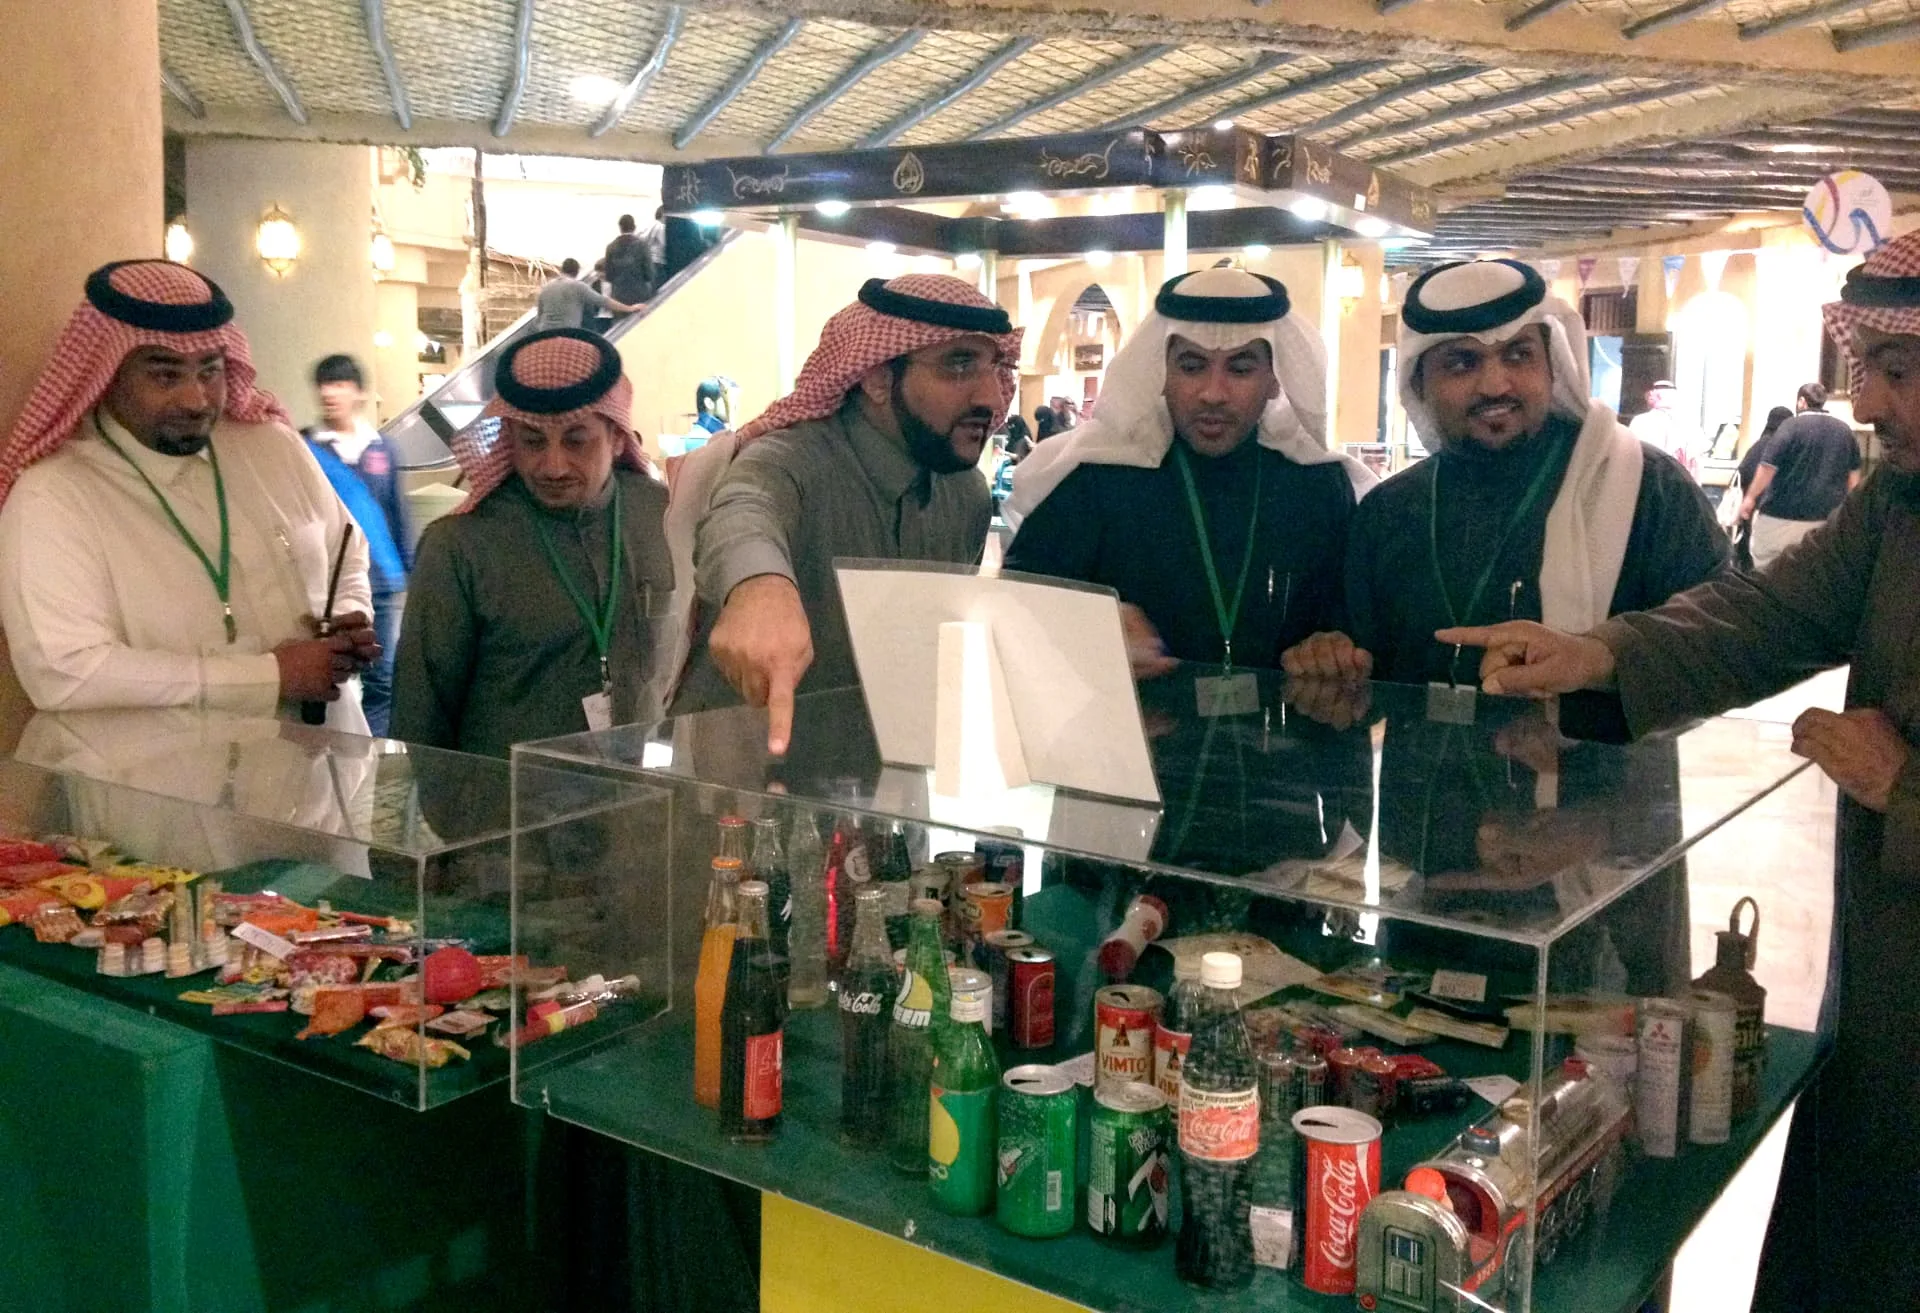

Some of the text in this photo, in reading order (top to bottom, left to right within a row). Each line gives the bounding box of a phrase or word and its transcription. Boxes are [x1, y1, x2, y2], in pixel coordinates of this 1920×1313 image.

[1101, 1052, 1147, 1073] VIMTO
[1158, 1078, 1180, 1098] VIM
[1320, 1153, 1357, 1270] Coca-Cola
